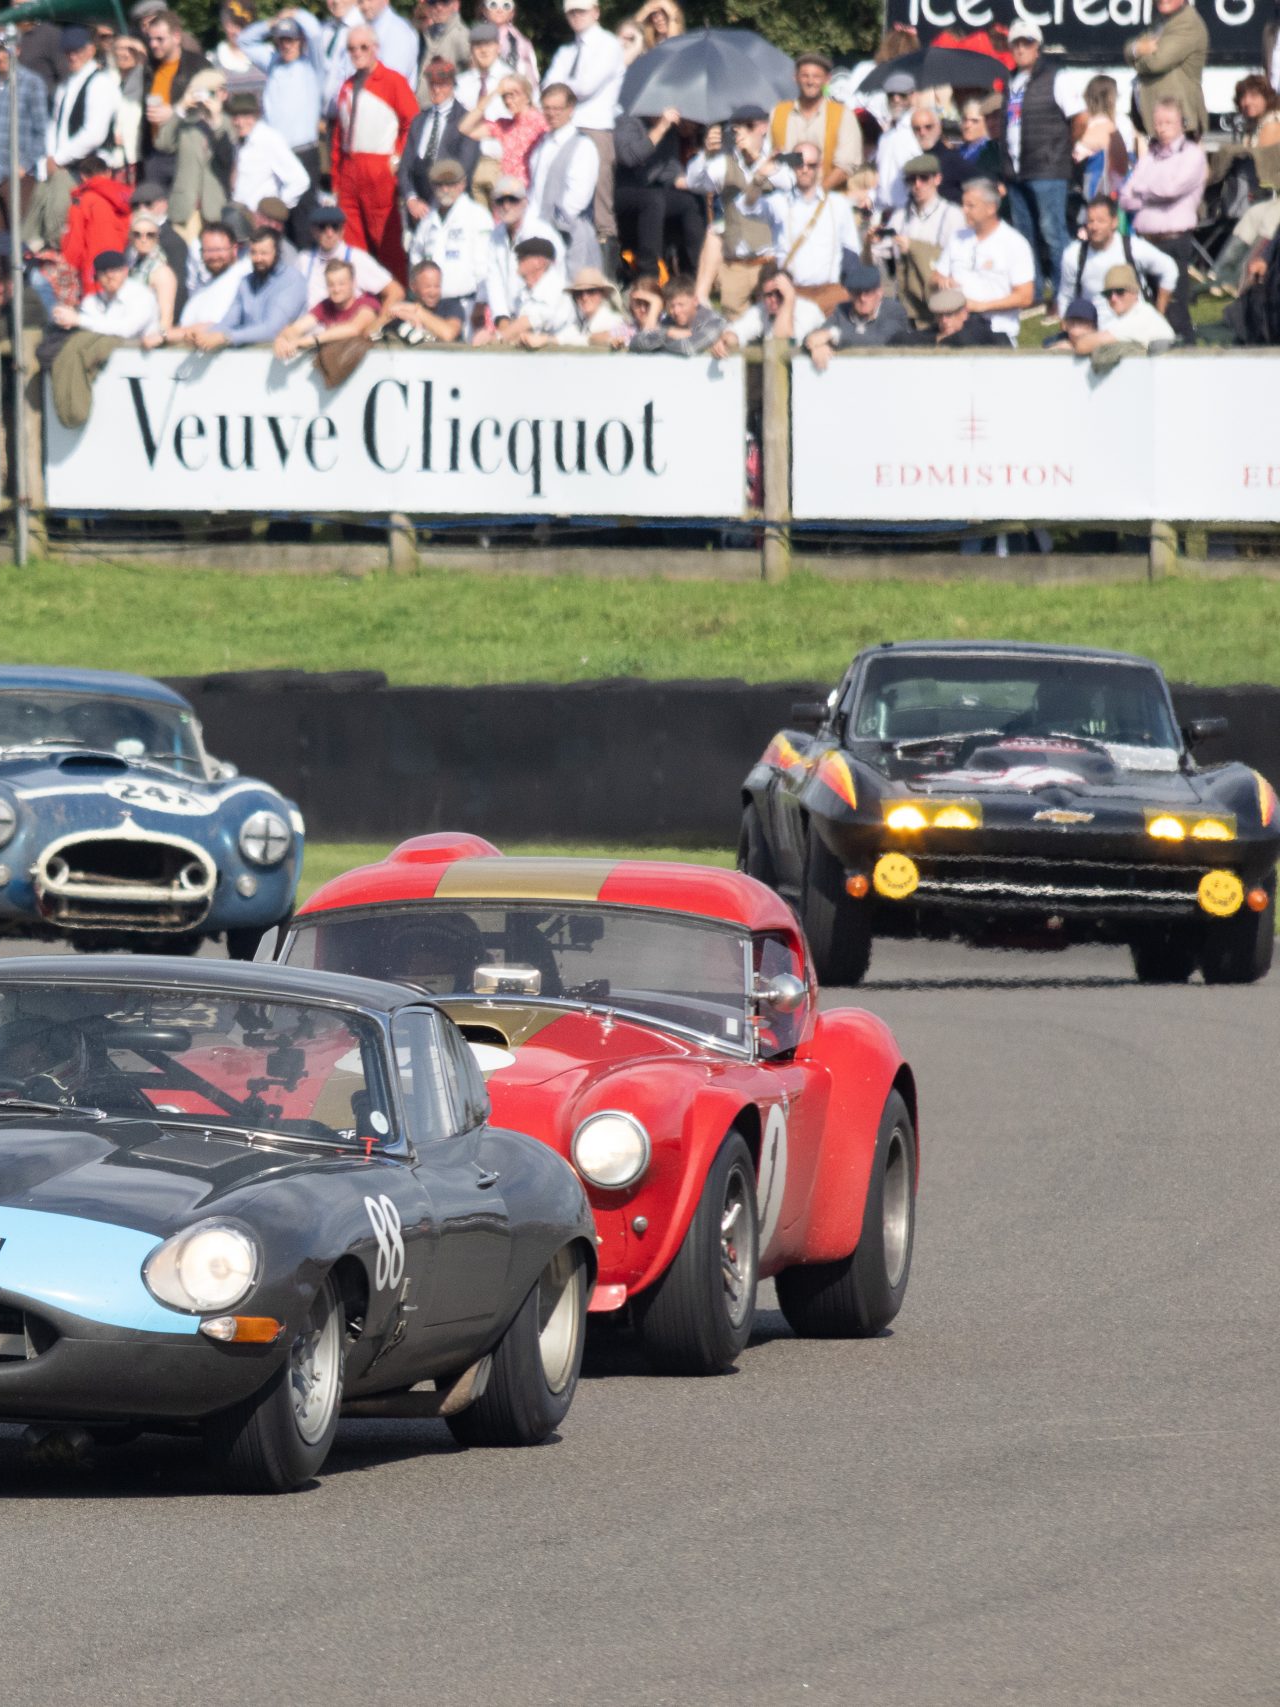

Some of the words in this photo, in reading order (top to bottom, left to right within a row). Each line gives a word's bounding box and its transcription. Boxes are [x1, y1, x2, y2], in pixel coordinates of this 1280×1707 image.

[121, 376, 338, 471] Veuve
[363, 379, 667, 498] Clicquot
[875, 463, 1074, 488] EDMISTON
[363, 1193, 405, 1291] 88
